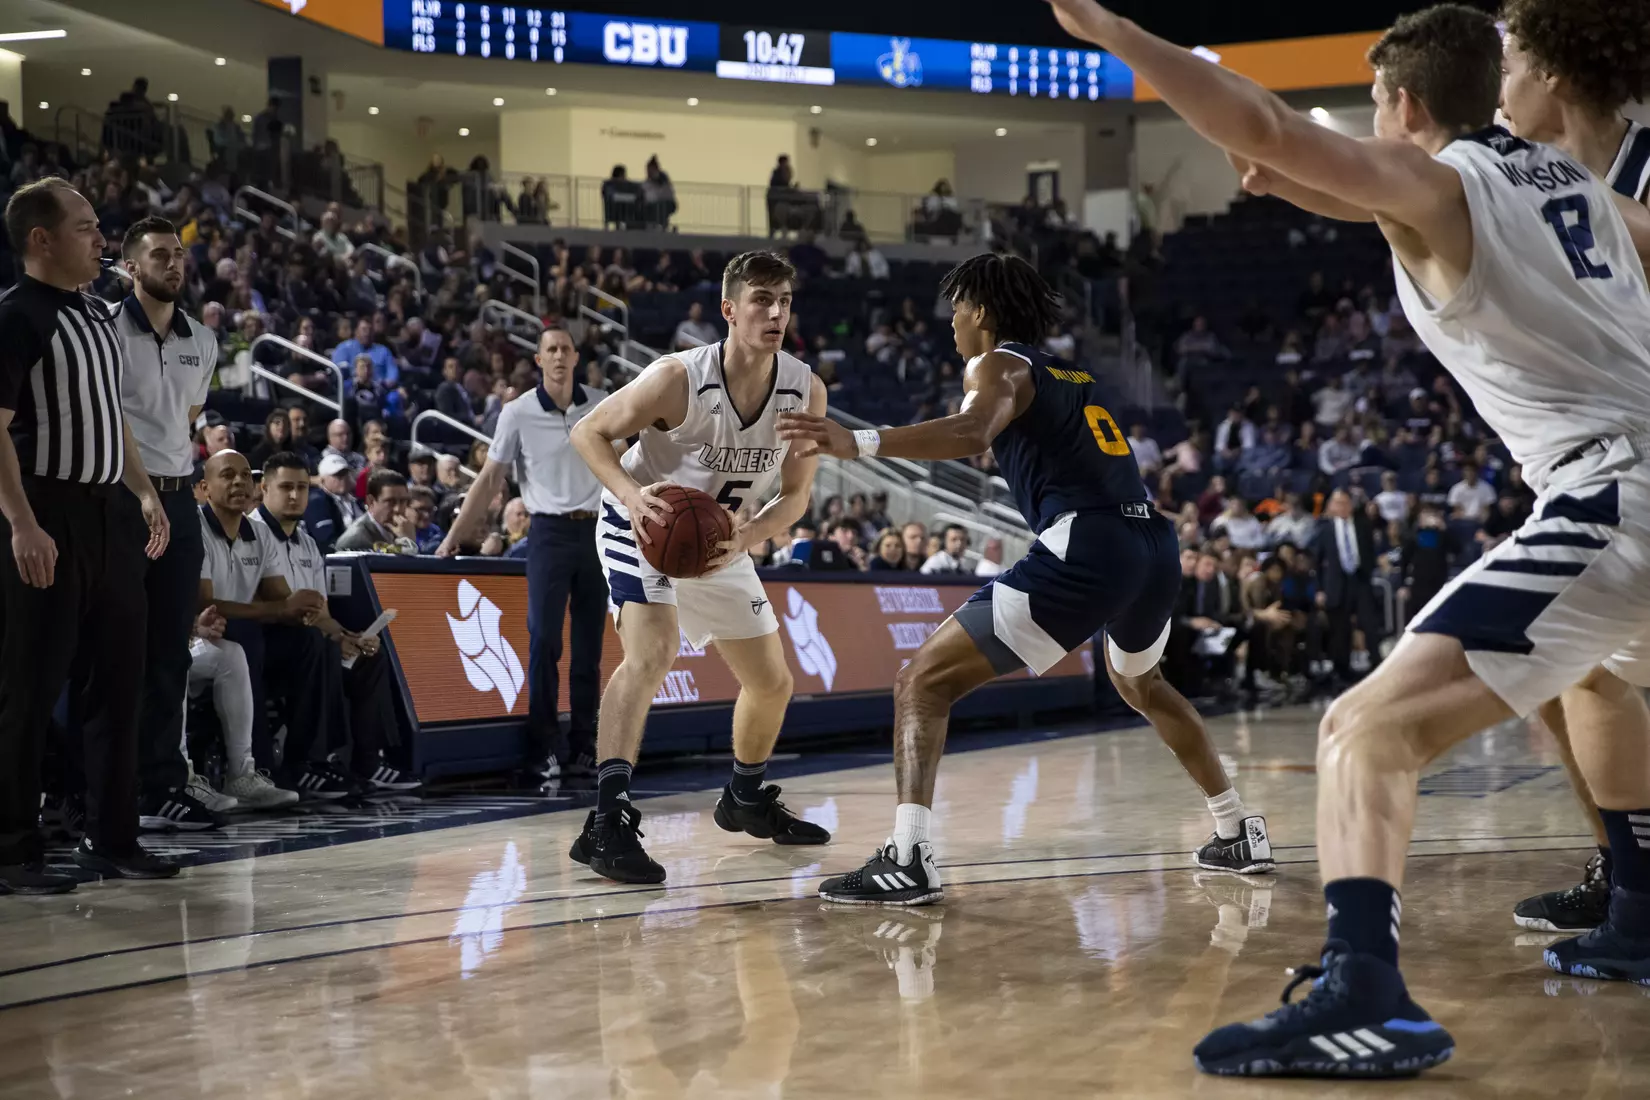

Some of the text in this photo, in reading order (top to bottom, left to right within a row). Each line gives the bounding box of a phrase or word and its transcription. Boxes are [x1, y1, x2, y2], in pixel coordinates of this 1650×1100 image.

[455, 3, 465, 20] 0
[526, 9, 542, 28] 12
[480, 23, 490, 40] 0
[529, 27, 539, 44] 0
[603, 21, 688, 67] CBU
[743, 30, 805, 66] 10:47
[456, 38, 466, 56] 0
[480, 40, 491, 58] 0
[505, 42, 515, 60] 0
[554, 46, 564, 64] 0
[1541, 194, 1613, 280] 12
[178, 354, 200, 367] CBU
[1084, 405, 1130, 456] 0
[698, 442, 782, 473] LANCERS
[716, 480, 753, 513] 5
[241, 556, 260, 566] CBU
